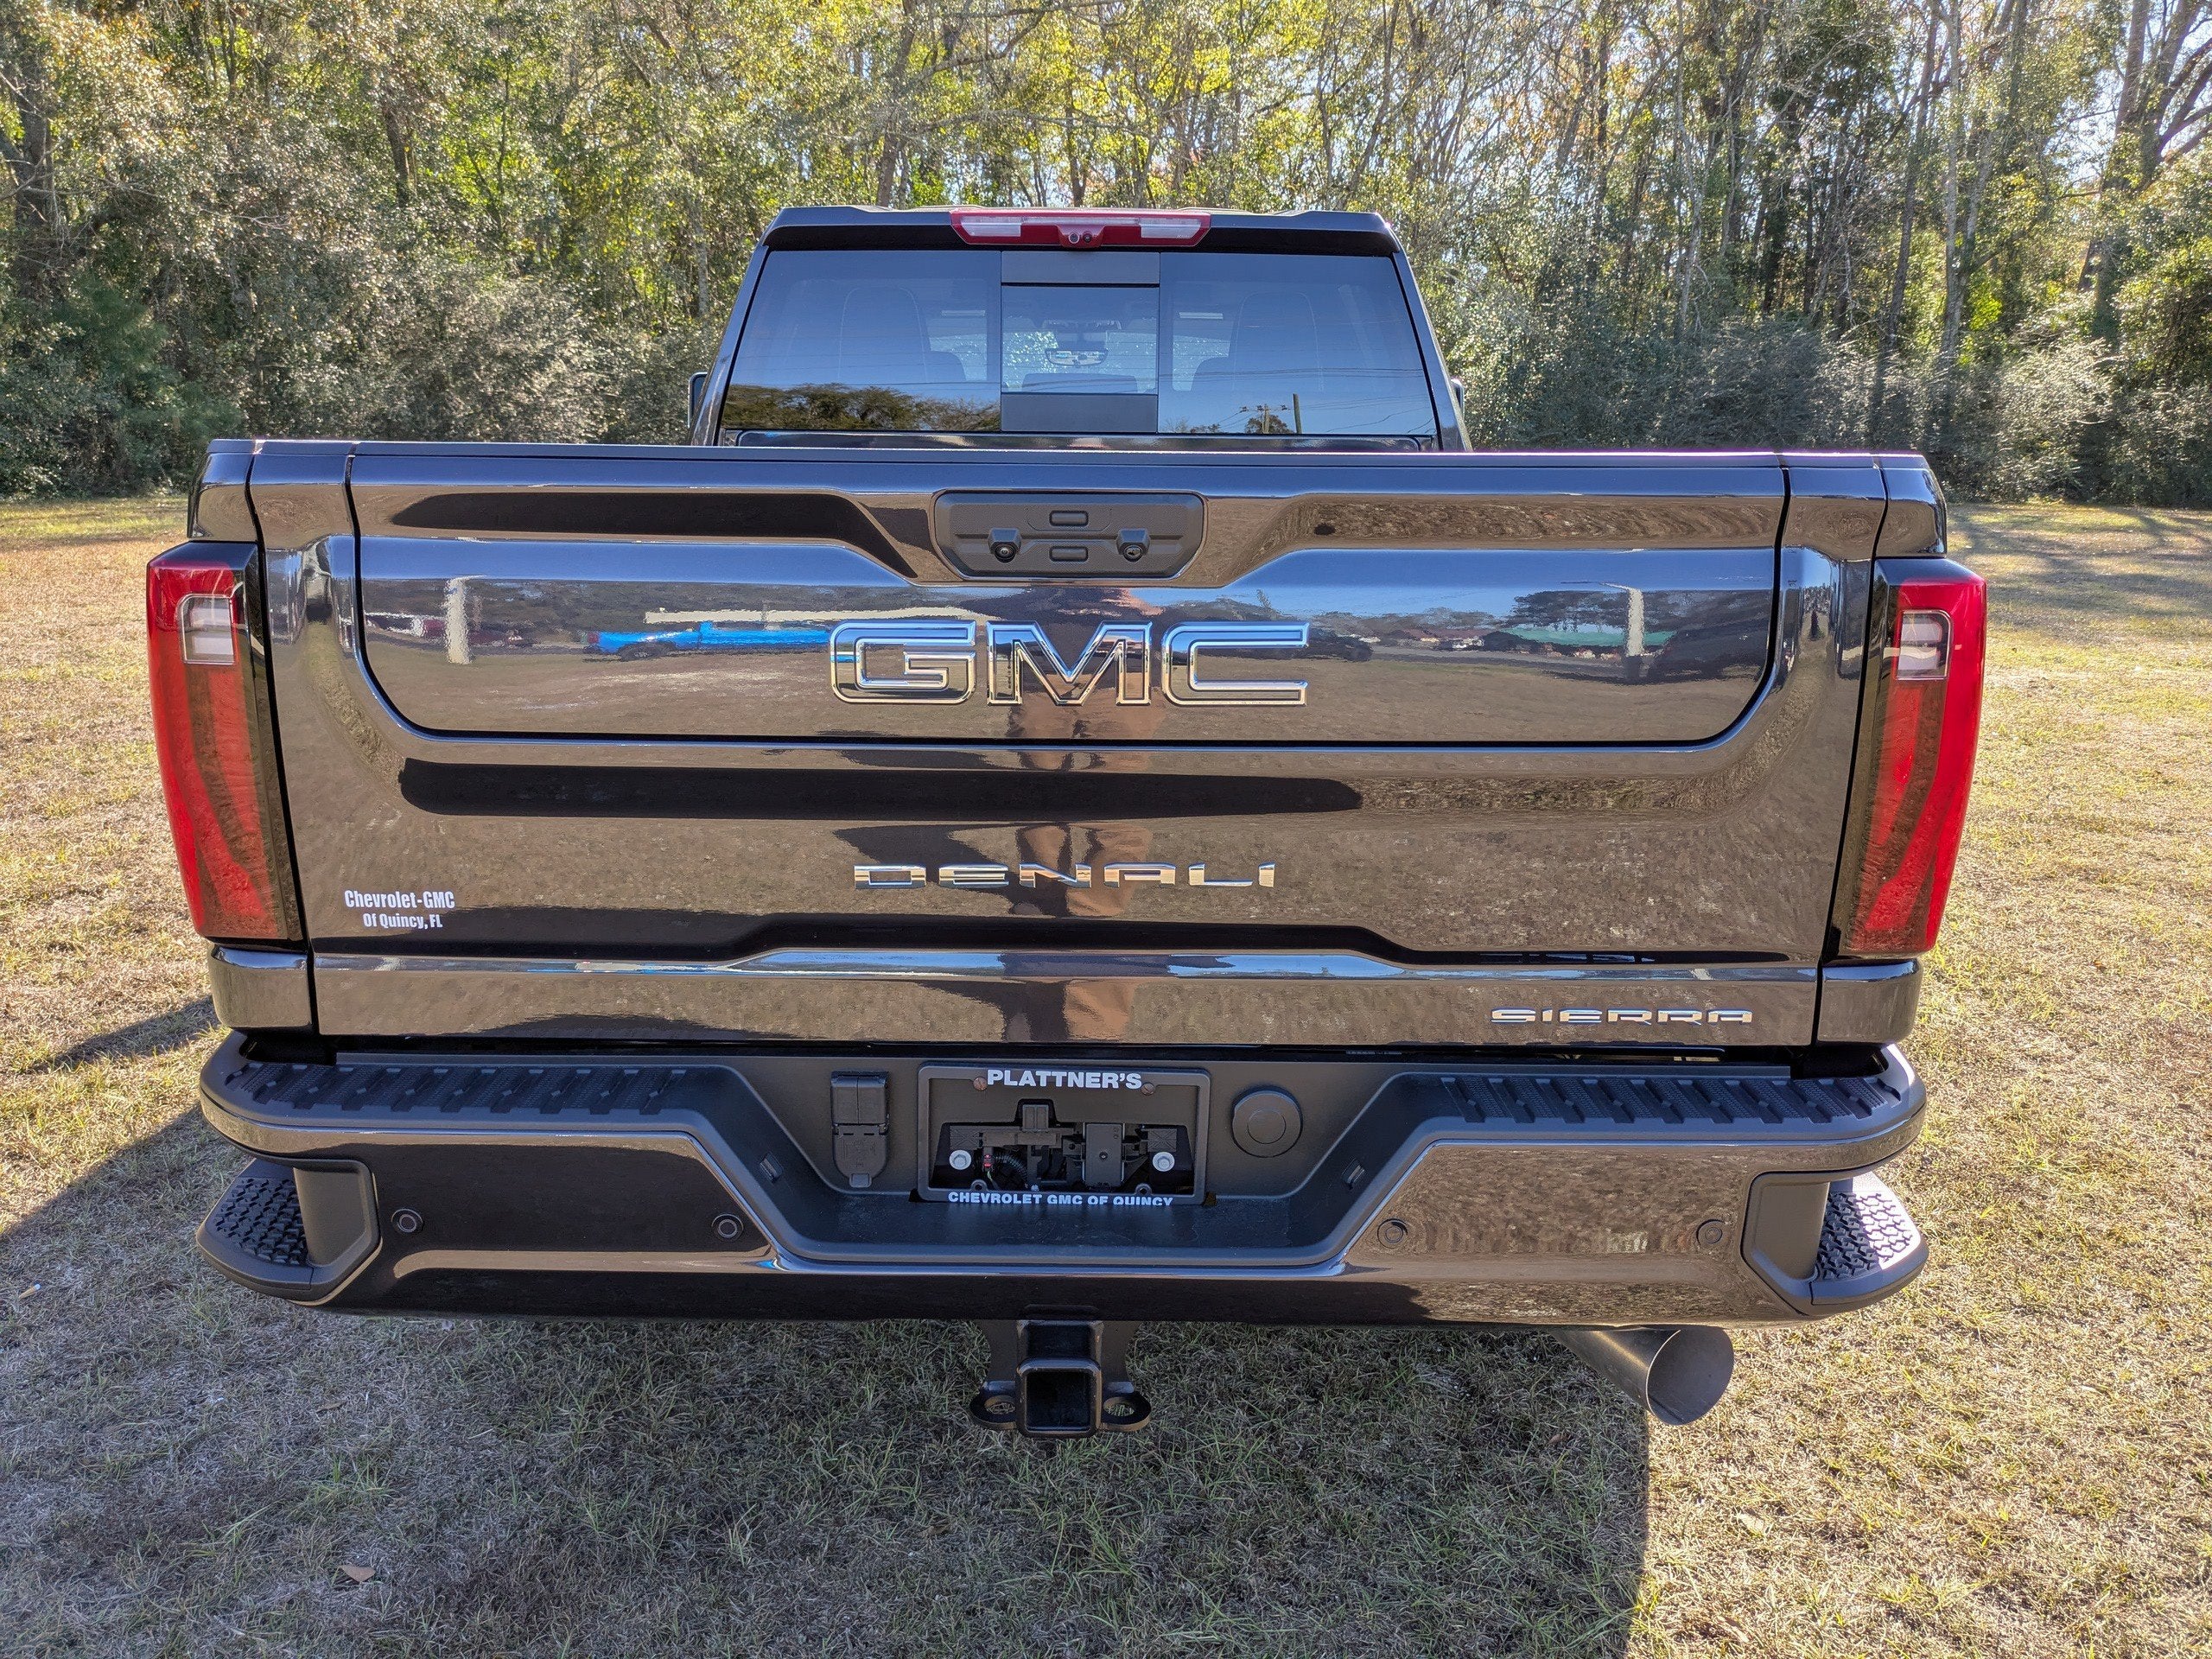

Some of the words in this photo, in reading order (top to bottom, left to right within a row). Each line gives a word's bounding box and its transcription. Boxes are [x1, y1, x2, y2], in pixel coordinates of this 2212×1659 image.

[830, 620, 1310, 706] GMC
[854, 863, 1276, 889] DENALI
[344, 889, 456, 909] Chevrolet-GMC
[363, 912, 378, 928] Of
[378, 912, 429, 930] Quincy,
[429, 914, 443, 928] FL
[1491, 1007, 1754, 1025] SIERRA
[987, 1069, 1142, 1090] PLATTNER'S
[948, 1192, 1043, 1205] CHEVROLET
[1046, 1194, 1083, 1205] GMC
[1087, 1195, 1109, 1205] OF
[1113, 1196, 1173, 1206] QUINCY
